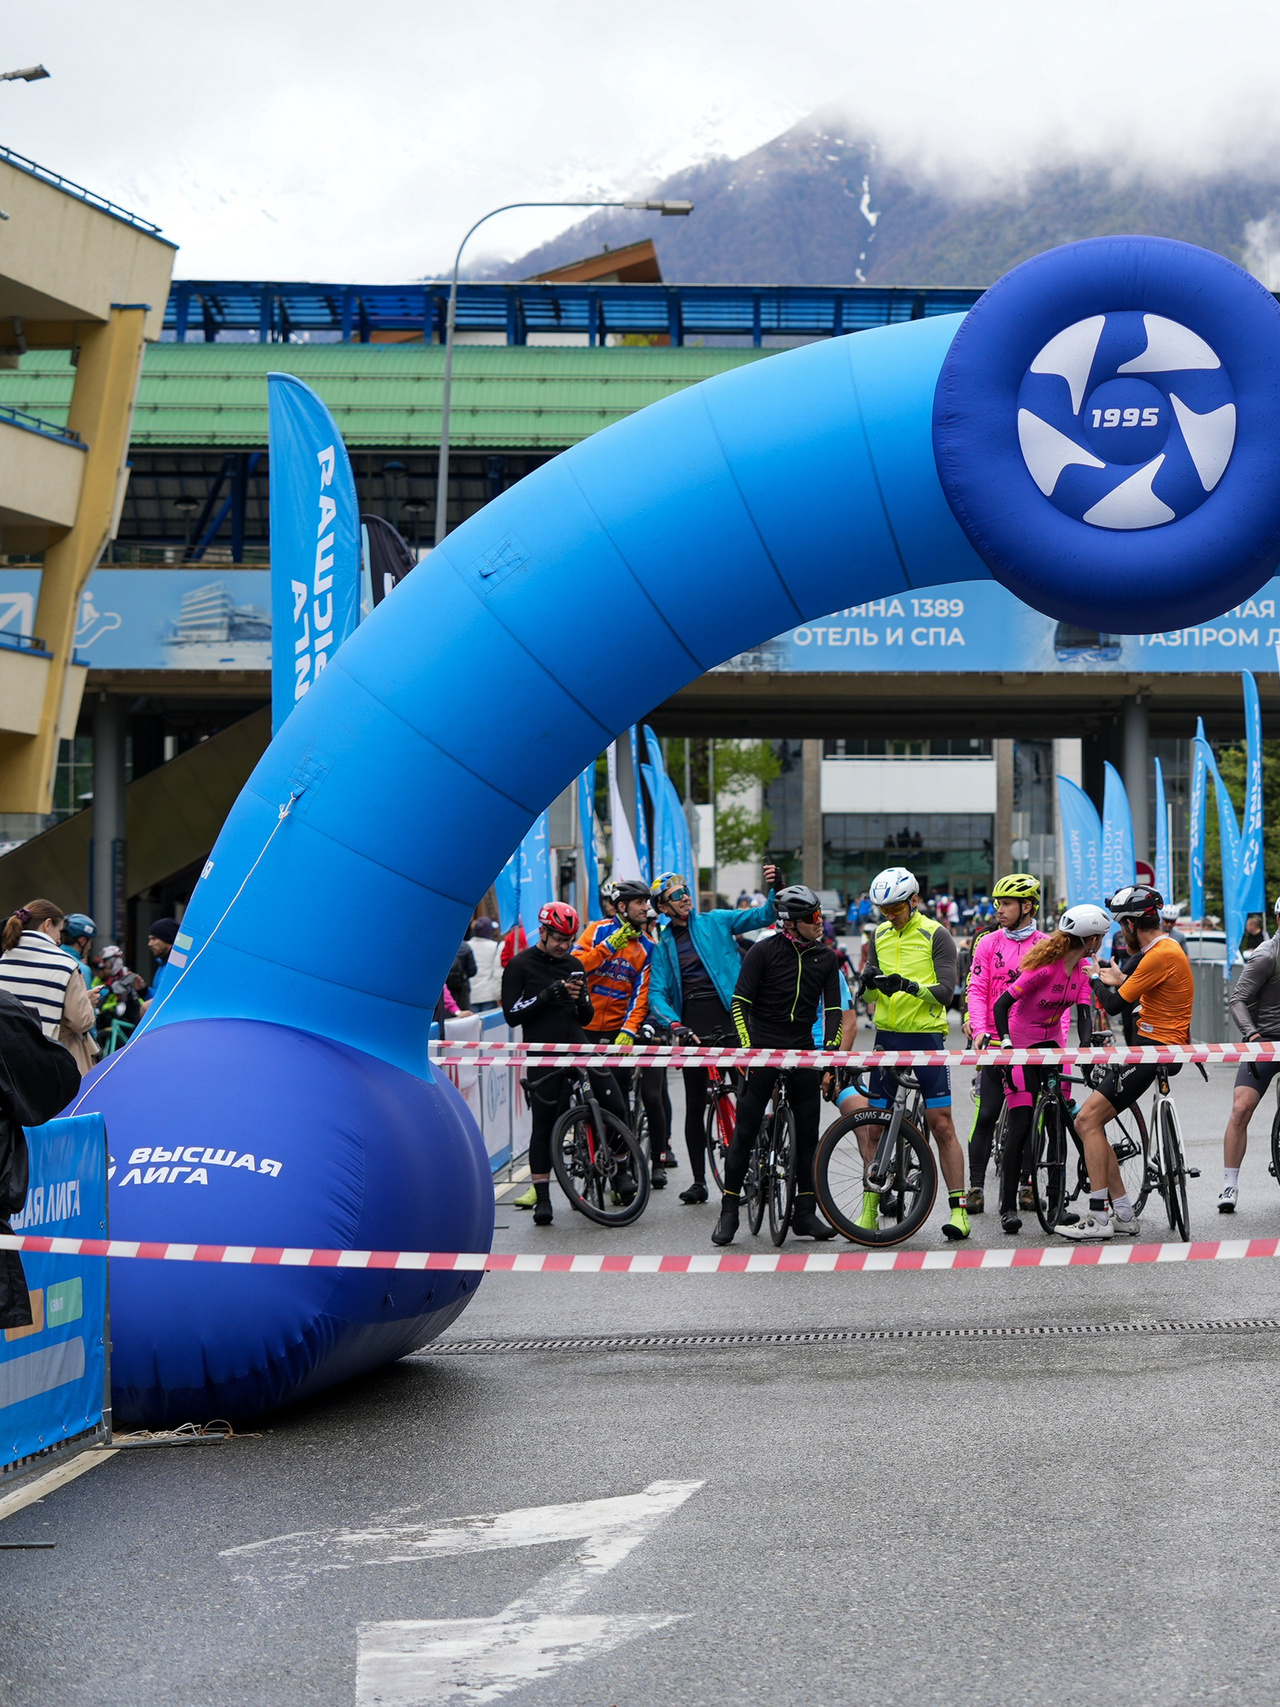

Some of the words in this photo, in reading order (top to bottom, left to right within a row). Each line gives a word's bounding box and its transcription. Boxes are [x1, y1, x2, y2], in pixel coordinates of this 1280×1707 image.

[1092, 408, 1160, 428] 1995
[910, 599, 965, 618] 1389
[793, 627, 879, 646] ОТЕЛЬ
[886, 627, 903, 646] И
[910, 627, 966, 646] СПА
[854, 1111, 877, 1122] SWISS
[879, 1112, 892, 1121] DT
[128, 1146, 284, 1178] ВЫСШАЯ
[117, 1166, 209, 1188] ЛИГА
[8, 1186, 44, 1231] ШАЯ
[45, 1179, 81, 1224] ЛИГА
